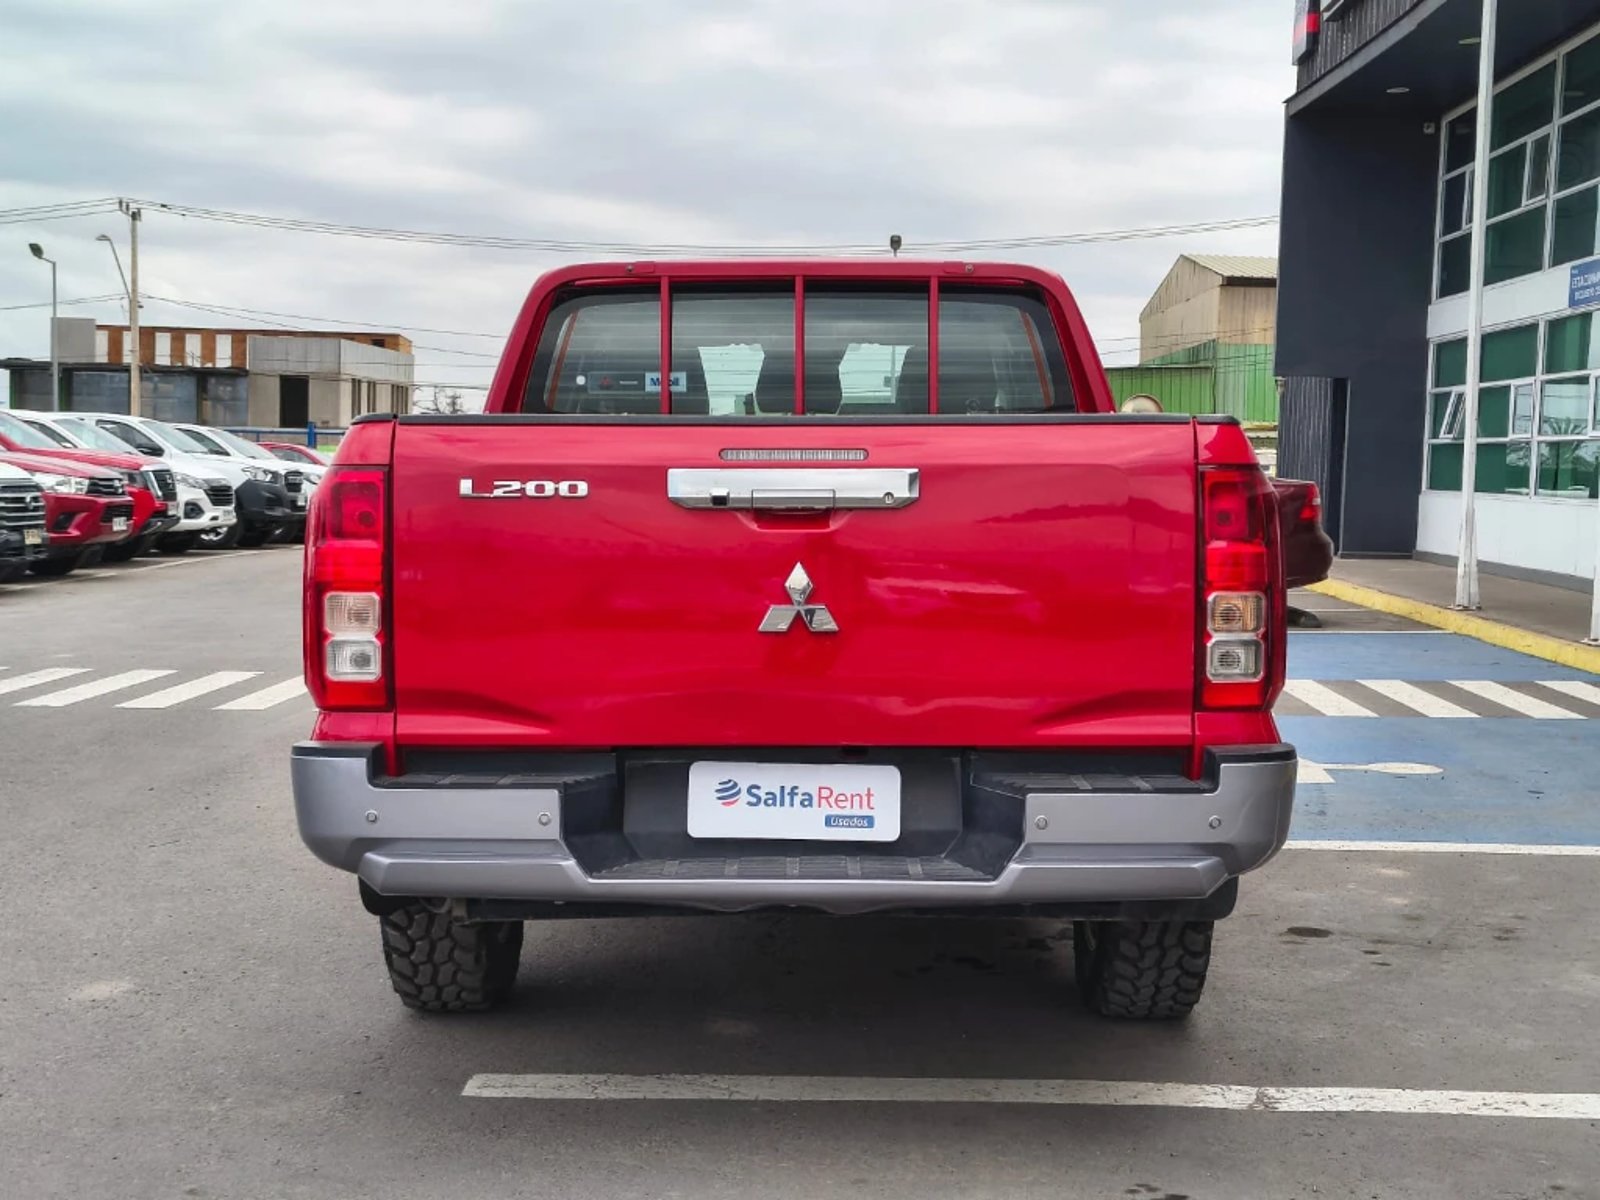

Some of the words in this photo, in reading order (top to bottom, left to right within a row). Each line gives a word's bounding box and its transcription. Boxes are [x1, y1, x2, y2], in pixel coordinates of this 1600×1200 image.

[650, 377, 680, 386] Mbil
[459, 478, 589, 498] L200
[746, 784, 875, 810] SalfaRent
[830, 816, 869, 827] Usados
